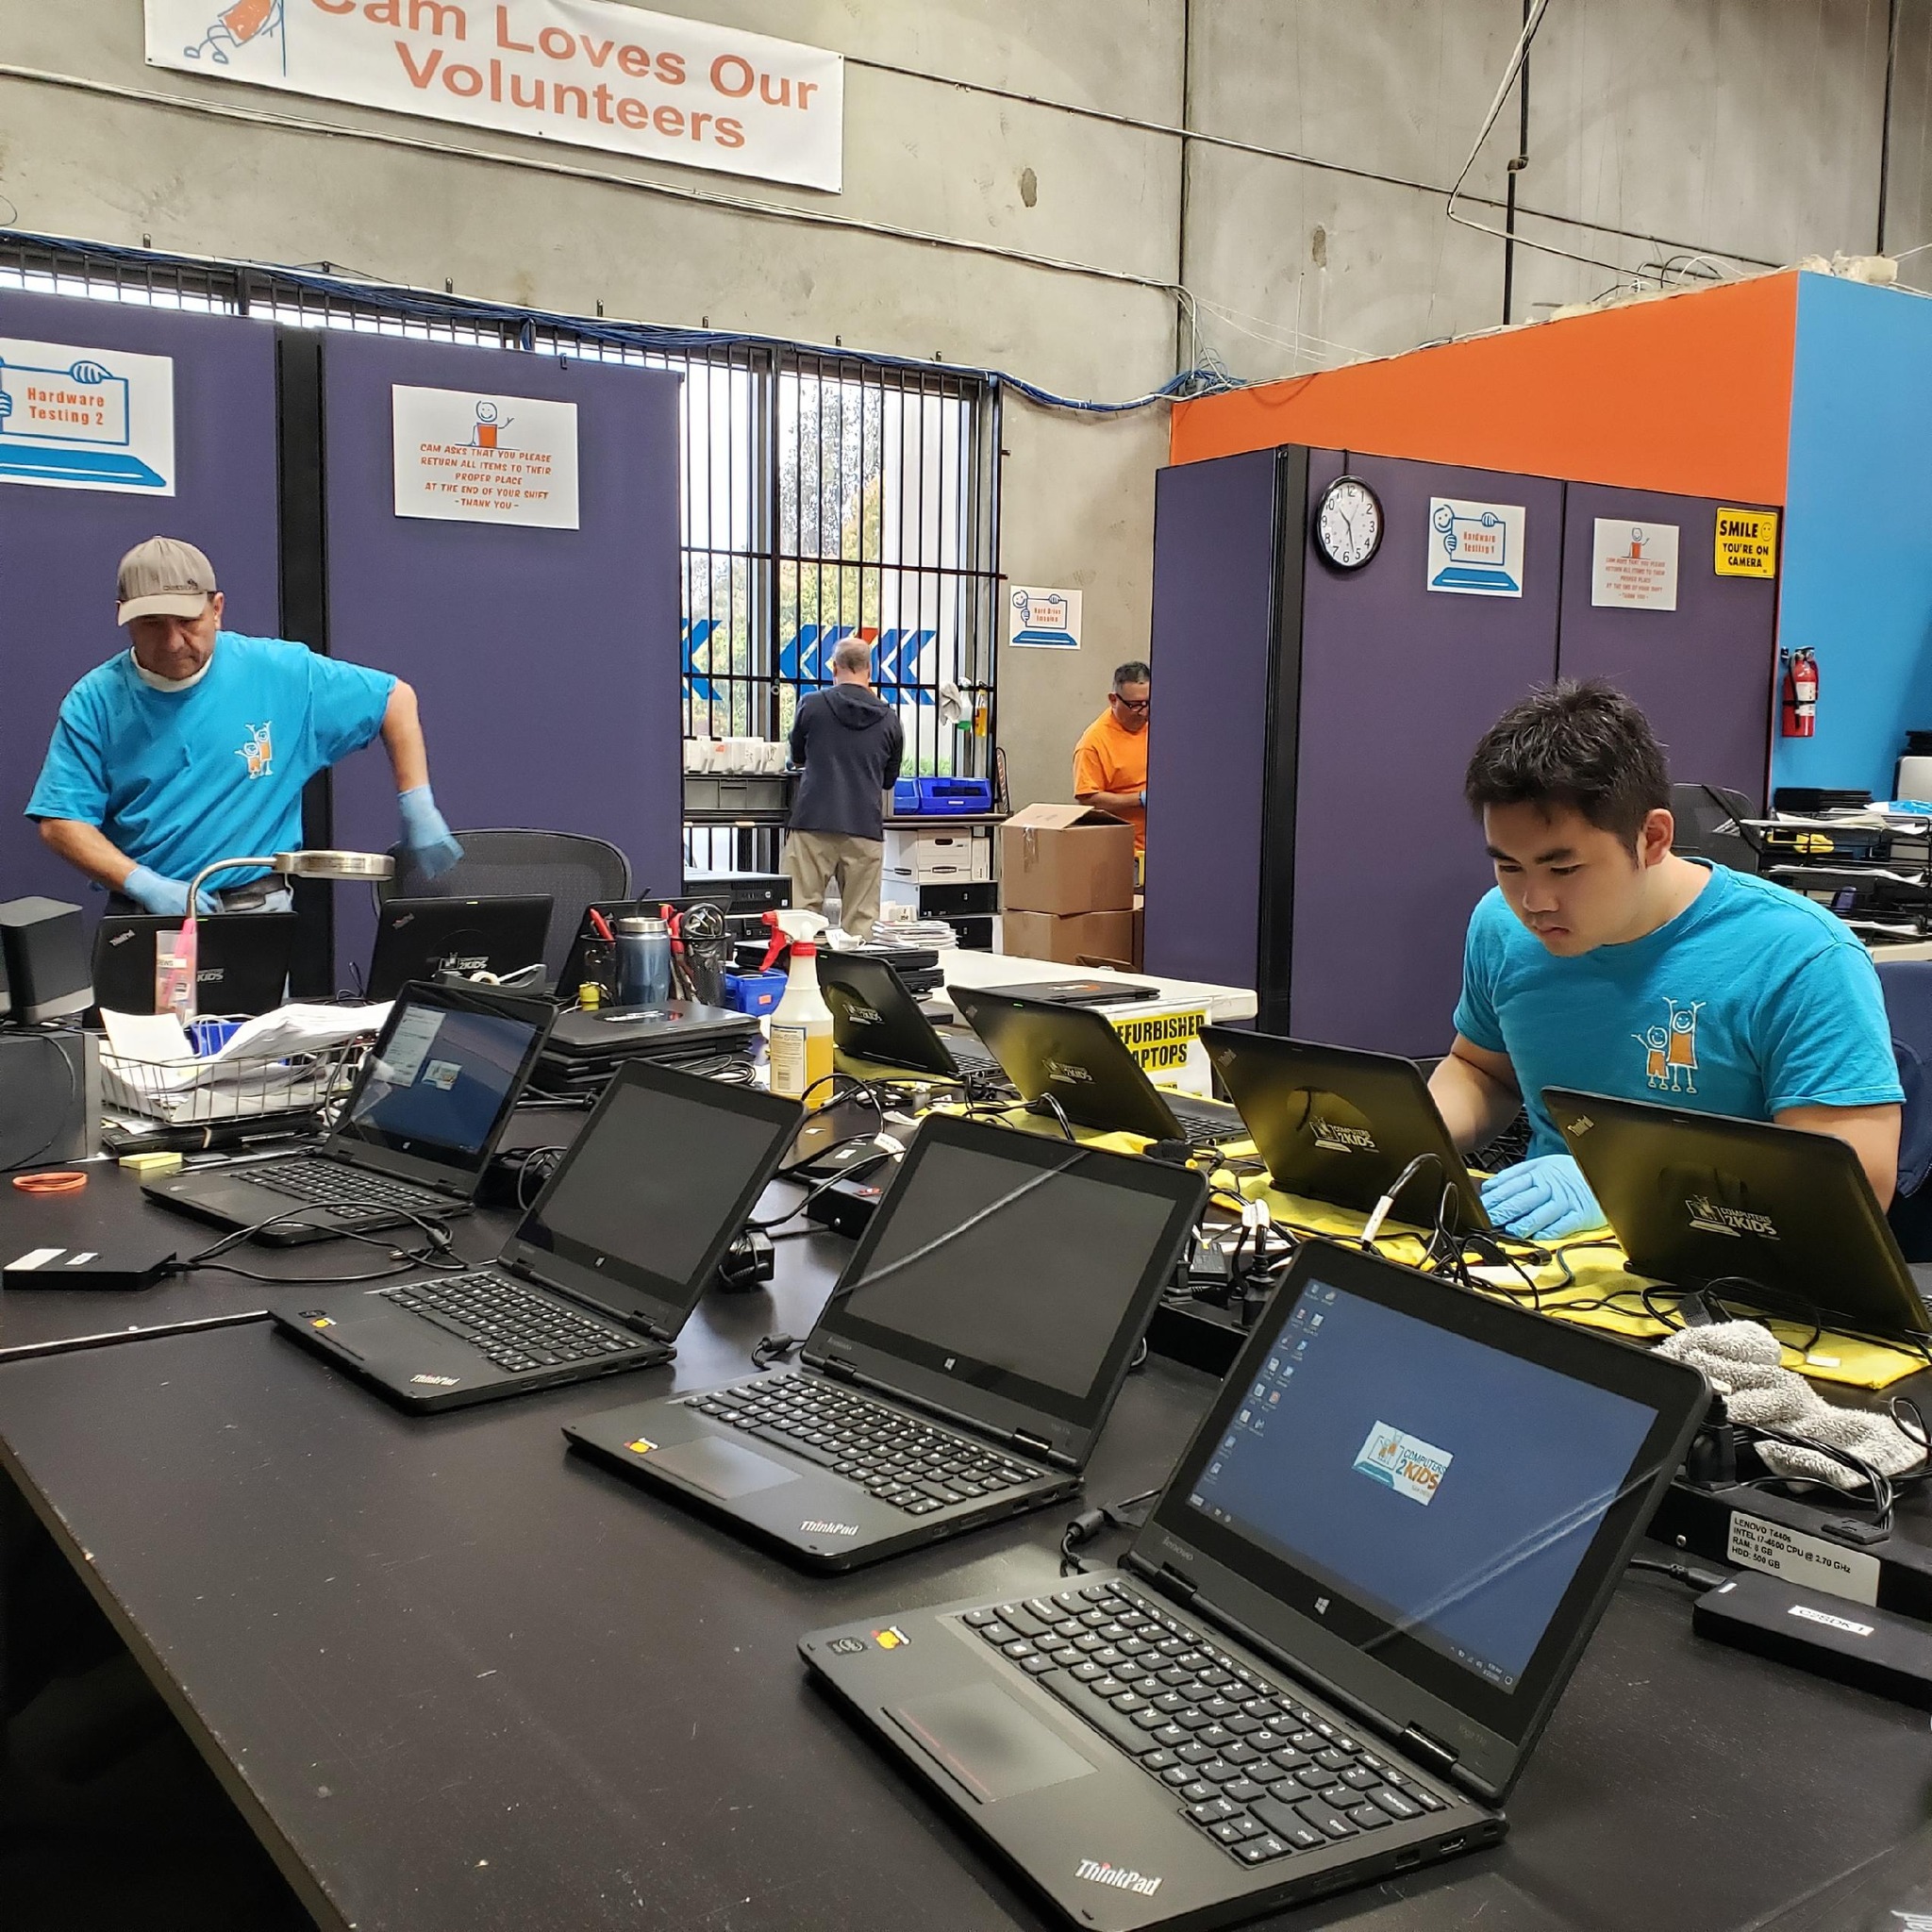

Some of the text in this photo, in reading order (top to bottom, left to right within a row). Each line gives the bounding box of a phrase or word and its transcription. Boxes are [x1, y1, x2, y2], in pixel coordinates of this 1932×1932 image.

[496, 5, 686, 86] Loves
[710, 54, 819, 110] Our
[393, 41, 745, 148] Volunteers
[27, 387, 105, 408] Hardware
[29, 406, 104, 425] Testing 2
[421, 443, 552, 463] CAM ASKS THAT YOU PLEASE
[421, 457, 551, 475] RETURN ALL ITEMS TO THEIR
[455, 473, 523, 485] PROPER PLACE
[425, 482, 549, 500] AT THE END OF YOUR SHIFT
[1346, 485, 1356, 497] 12
[1366, 503, 1373, 515] 2
[1321, 515, 1327, 527] 9
[1369, 521, 1375, 533] 3
[1720, 520, 1758, 538] SMILE
[1324, 533, 1331, 544] 8
[1364, 538, 1370, 549] 4
[1332, 545, 1340, 557] 7
[1342, 551, 1350, 563] 6
[1355, 548, 1361, 559] 5
[1723, 543, 1769, 556] YOU'RE ON
[1728, 556, 1762, 567] CAMERA
[196, 973, 225, 982] KIDS
[1117, 1014, 1205, 1044] EFURBISHED
[1132, 1043, 1187, 1068] APTOPS
[1337, 1132, 1375, 1148] 2KIDS
[1724, 1215, 1777, 1236] 2KIDS
[1403, 1448, 1448, 1474] COMPUTERS
[1395, 1458, 1441, 1491] 2KIDS
[800, 1520, 859, 1537] ThinkPad
[1734, 1517, 1767, 1534] LENOVO
[1733, 1536, 1752, 1550] RAM:
[1760, 1545, 1773, 1557] GB
[1733, 1526, 1756, 1541] INTEL
[1786, 1545, 1804, 1557] CPU
[1805, 1552, 1814, 1562] @
[1815, 1555, 1832, 1567] 2.70
[1833, 1561, 1851, 1574] GHz
[1731, 1546, 1780, 1570] HDD: 500 GB
[1074, 1858, 1163, 1896] ThinkPad
